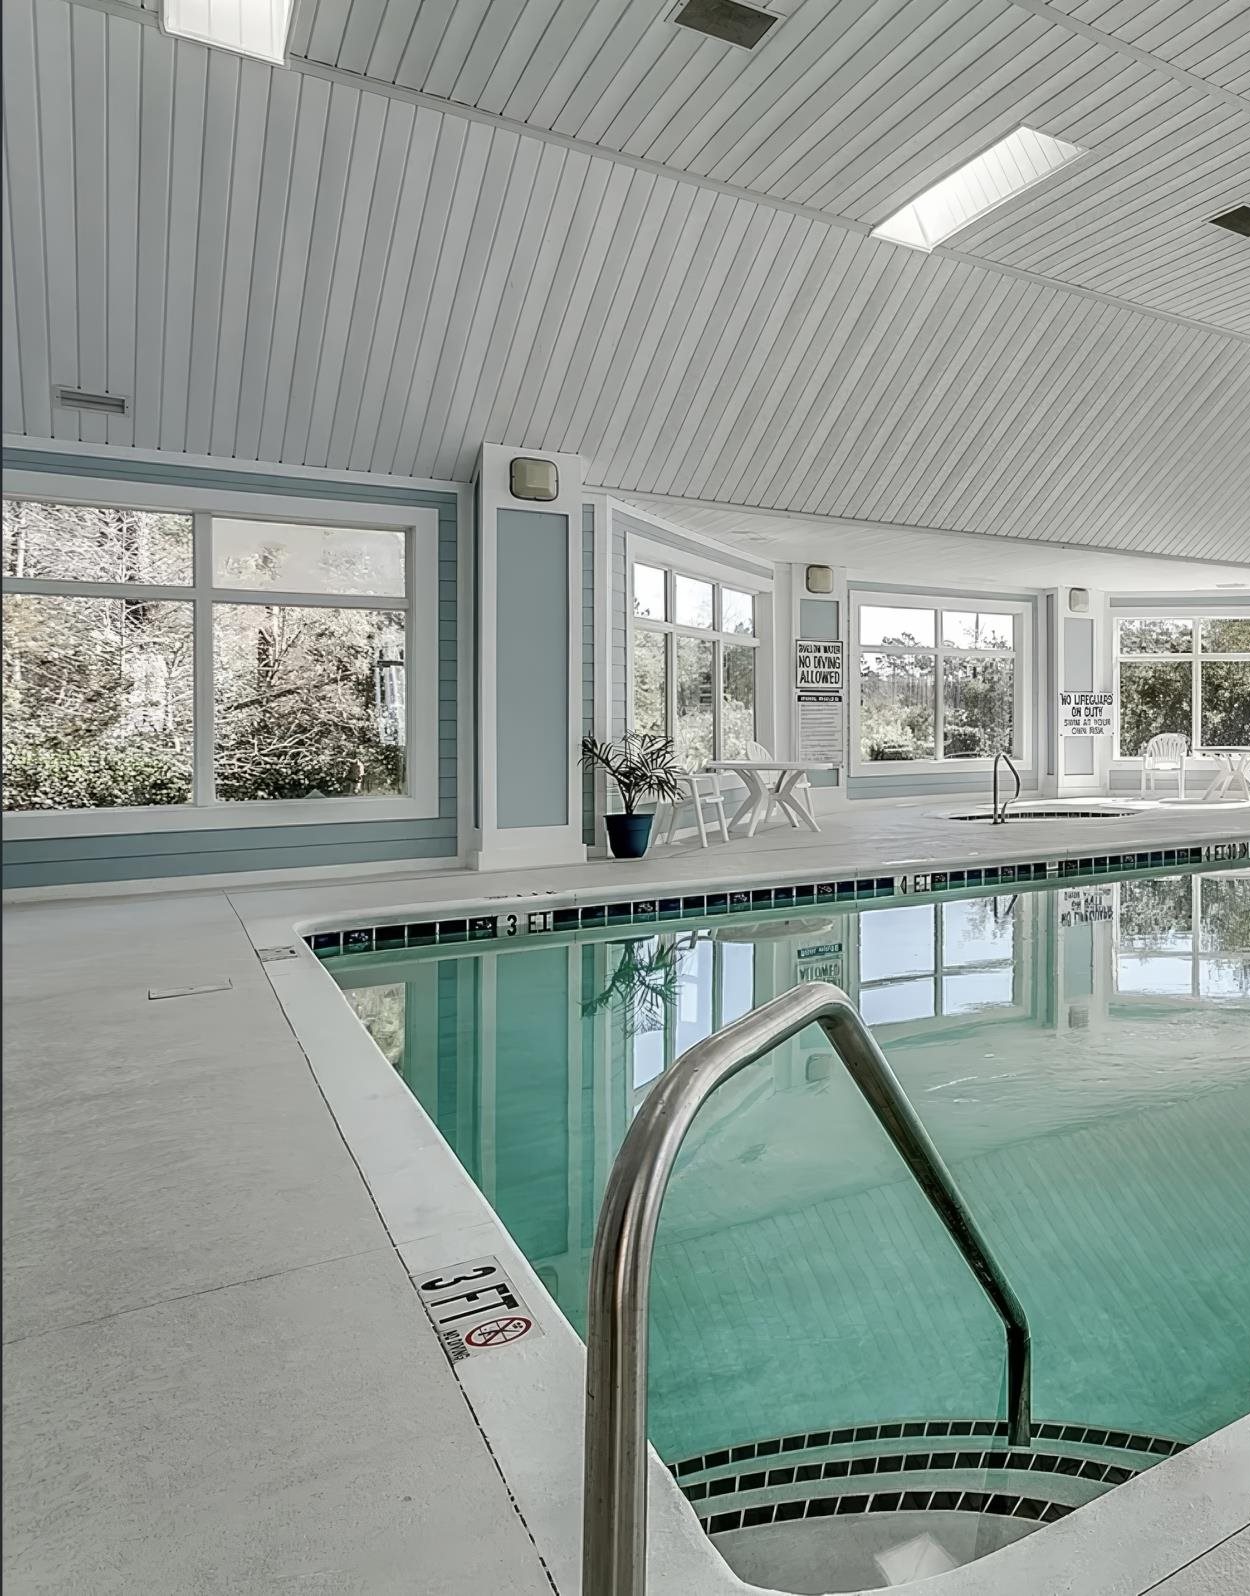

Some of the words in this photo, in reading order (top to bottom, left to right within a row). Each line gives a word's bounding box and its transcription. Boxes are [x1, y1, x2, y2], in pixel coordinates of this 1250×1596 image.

[798, 655, 811, 668] NO
[814, 656, 841, 669] DIVING
[800, 670, 840, 684] ALLOWED
[1061, 694, 1072, 705] NO
[1074, 694, 1113, 705] LIFEGUARD
[1071, 706, 1081, 717] ON
[507, 914, 518, 937] 3
[420, 1266, 496, 1291] 3
[430, 1283, 520, 1325] FT
